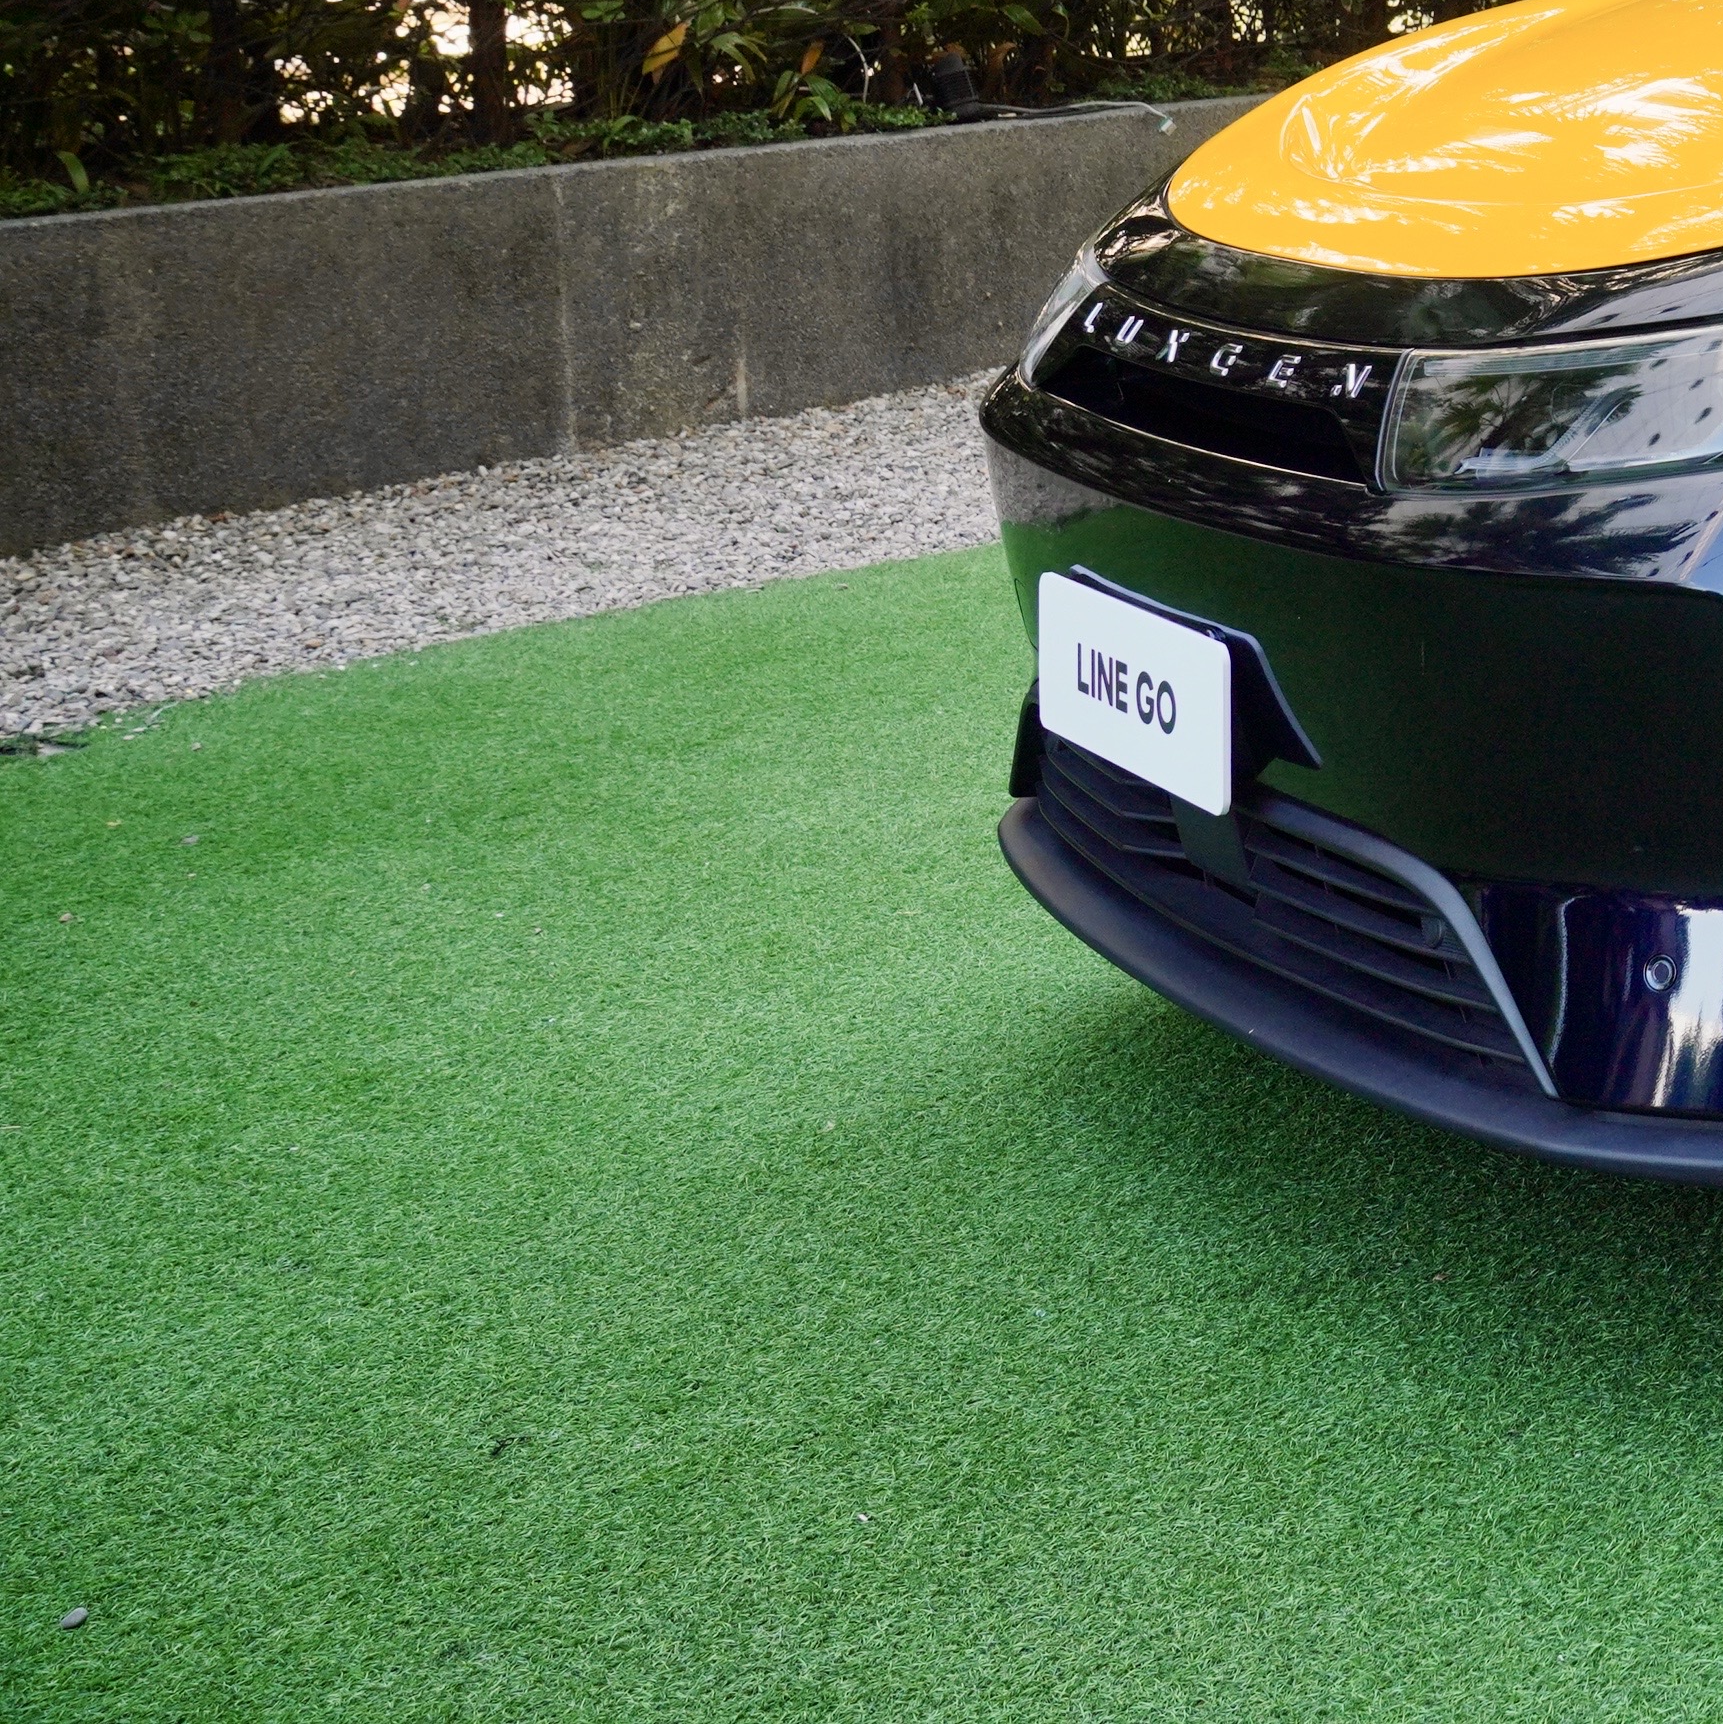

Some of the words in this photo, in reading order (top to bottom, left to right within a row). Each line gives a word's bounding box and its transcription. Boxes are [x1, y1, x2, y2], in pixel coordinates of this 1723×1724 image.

[1083, 302, 1372, 399] LUXGEN
[1077, 642, 1128, 714] LINE
[1136, 671, 1177, 735] GO
